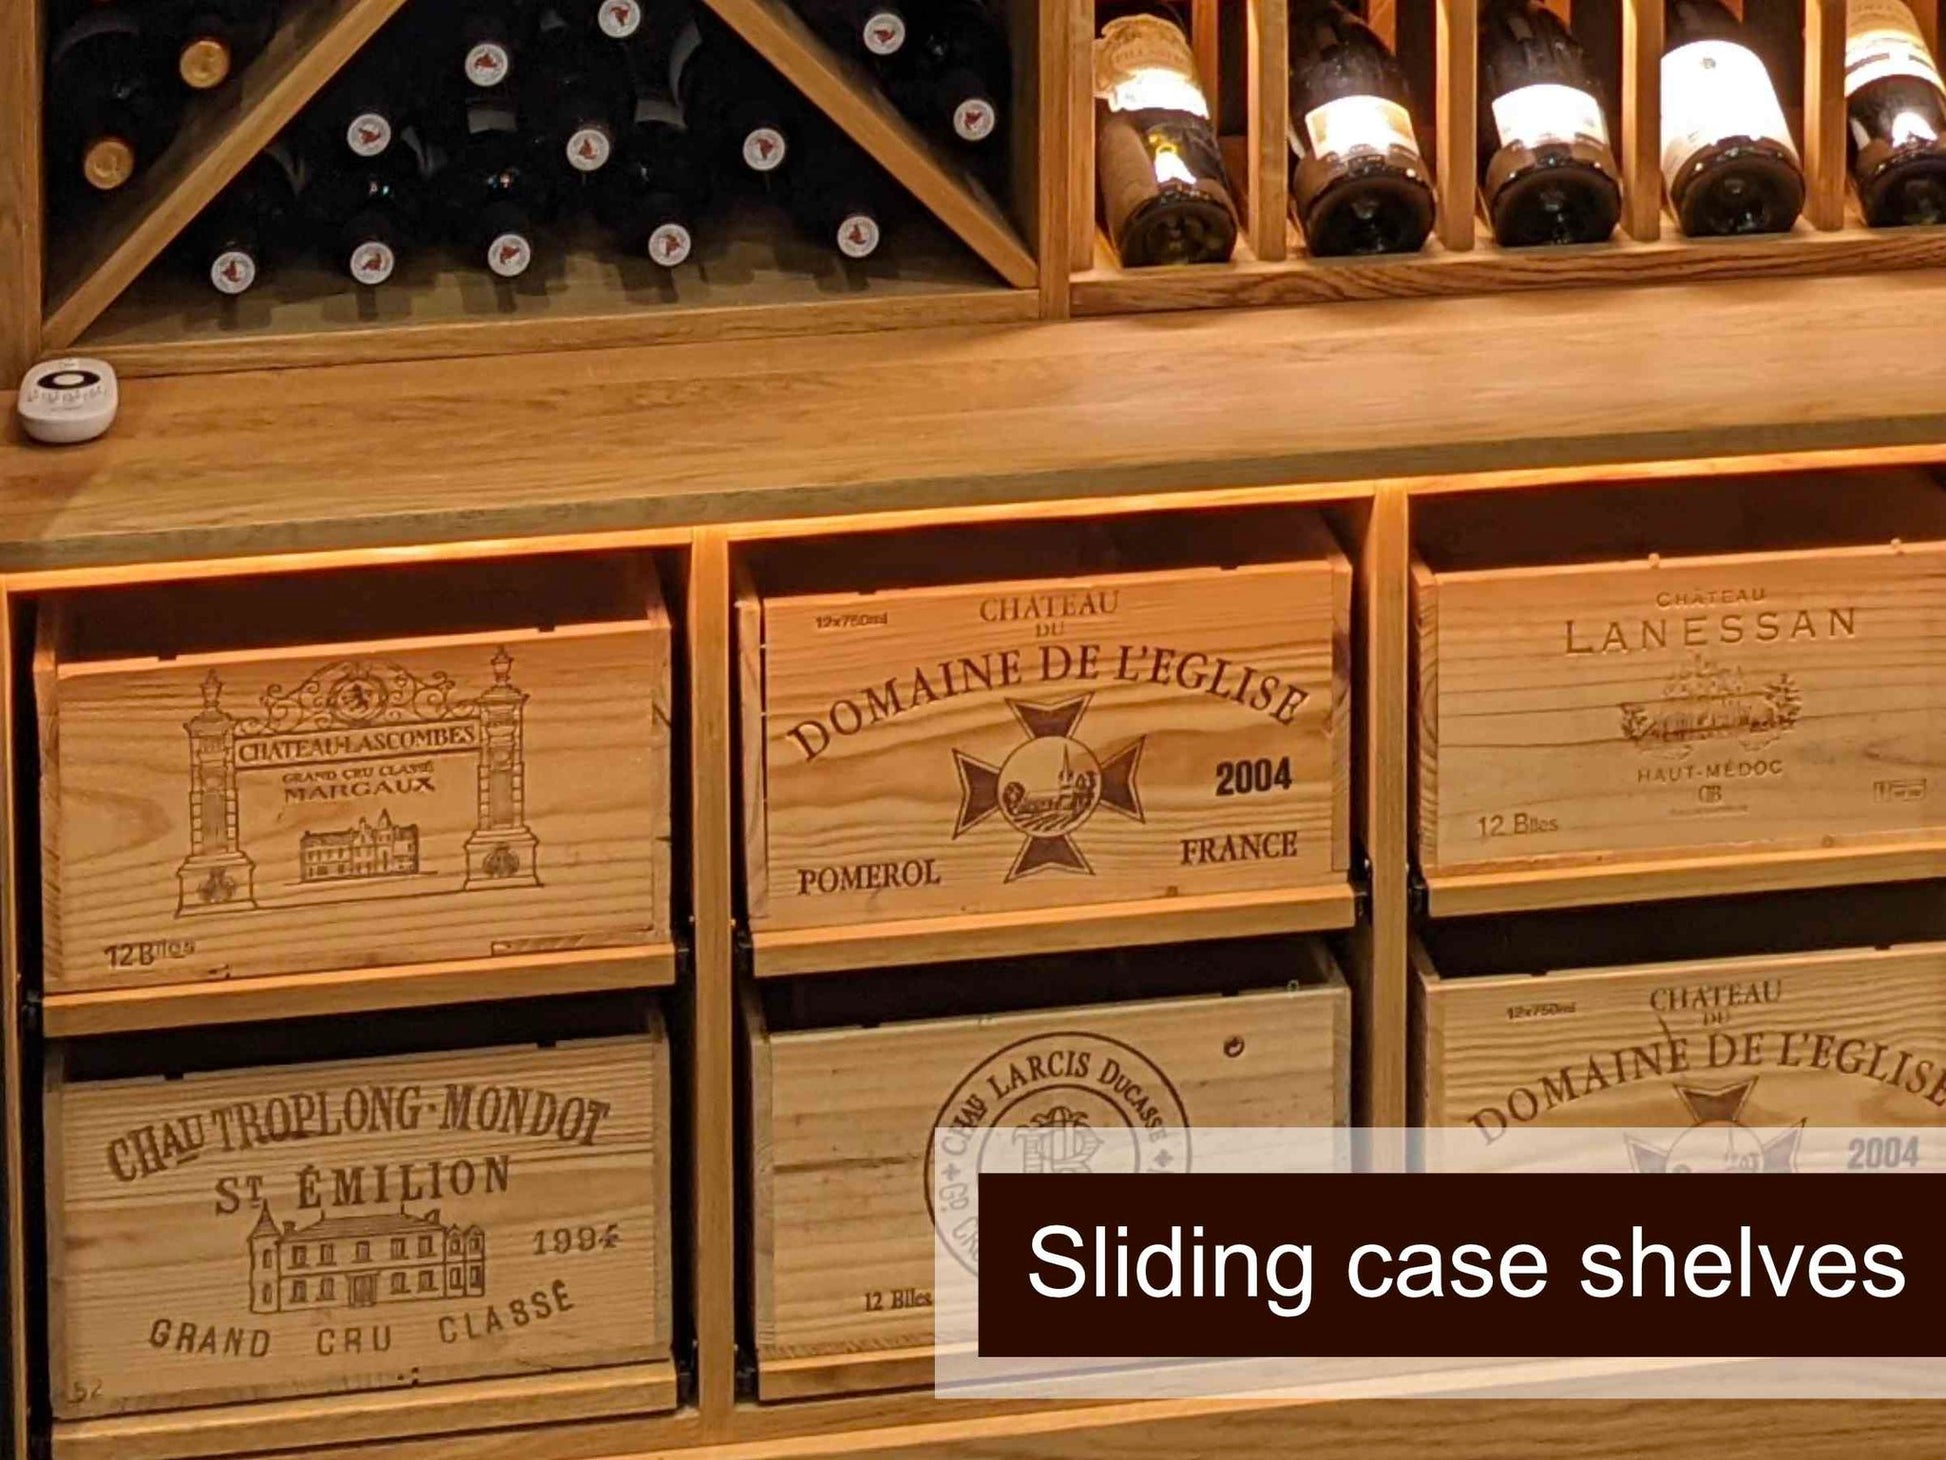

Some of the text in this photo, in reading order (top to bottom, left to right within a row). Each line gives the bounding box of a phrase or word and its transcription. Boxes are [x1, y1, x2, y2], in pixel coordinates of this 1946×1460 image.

[1035, 622, 1064, 637] DU
[1565, 607, 1855, 654] LANESSAN
[787, 645, 1309, 761] DOMAINE DE L'EGLISE
[282, 771, 337, 783] GRAND
[342, 767, 374, 780] CRU
[285, 777, 436, 800] MARGAUX
[1216, 756, 1293, 796] 2004
[1478, 815, 1505, 837] 12
[1180, 831, 1298, 866] FRANCE
[797, 859, 942, 896] POMEROL
[986, 1050, 1091, 1100] LARCIS
[1466, 1038, 1690, 1146] DOMAINE
[1707, 1032, 1763, 1068] DE
[1847, 1136, 1919, 1169] 2004
[865, 1290, 883, 1311] 12
[149, 1319, 270, 1357] GRAND
[316, 1326, 392, 1355] CRU
